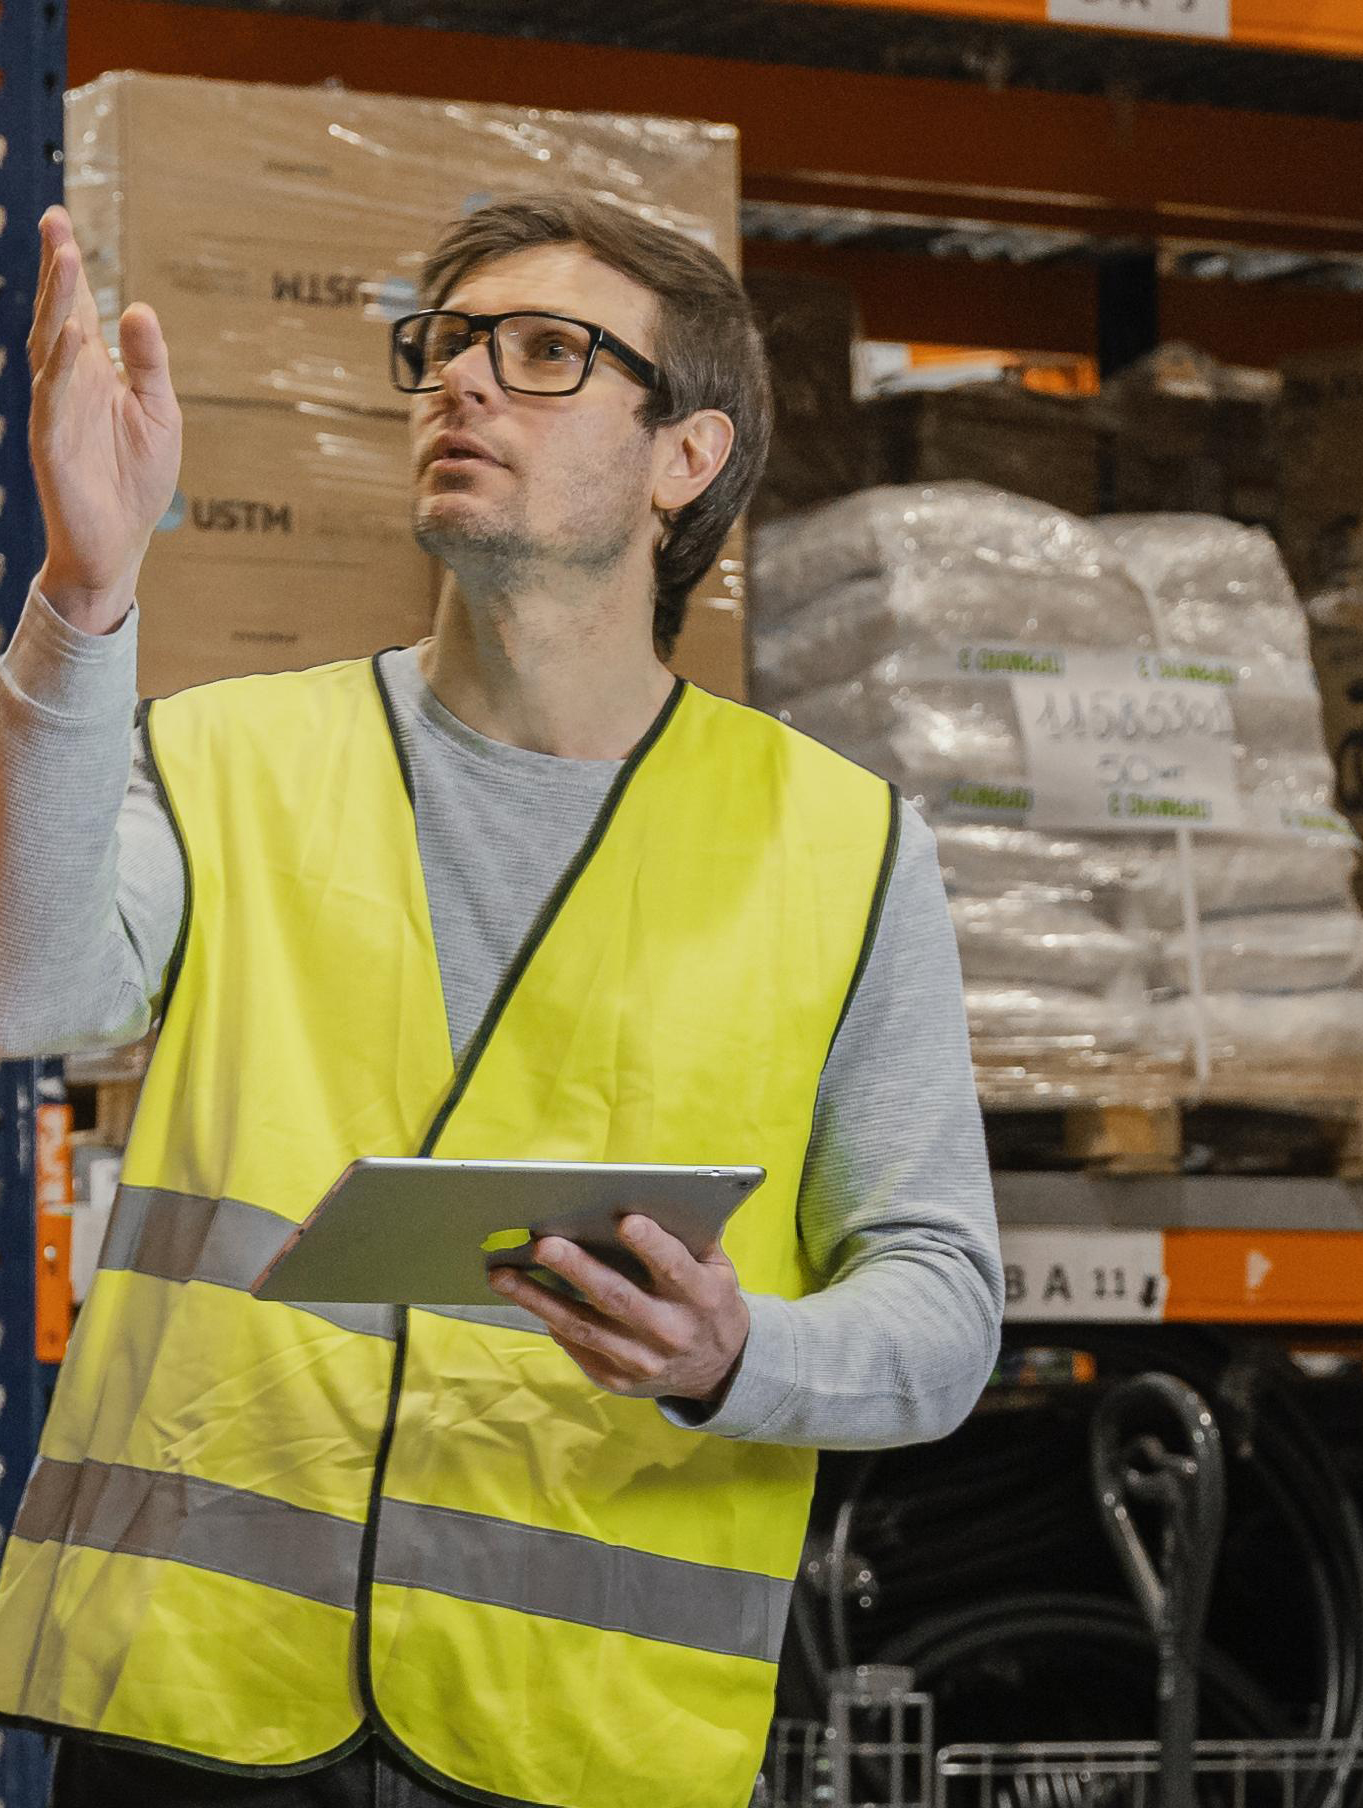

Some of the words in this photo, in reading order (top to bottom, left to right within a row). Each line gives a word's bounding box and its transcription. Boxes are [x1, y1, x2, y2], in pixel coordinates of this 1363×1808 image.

[191, 497, 292, 533] USTM
[1004, 1264, 1028, 1302] B
[1041, 1263, 1073, 1303] A
